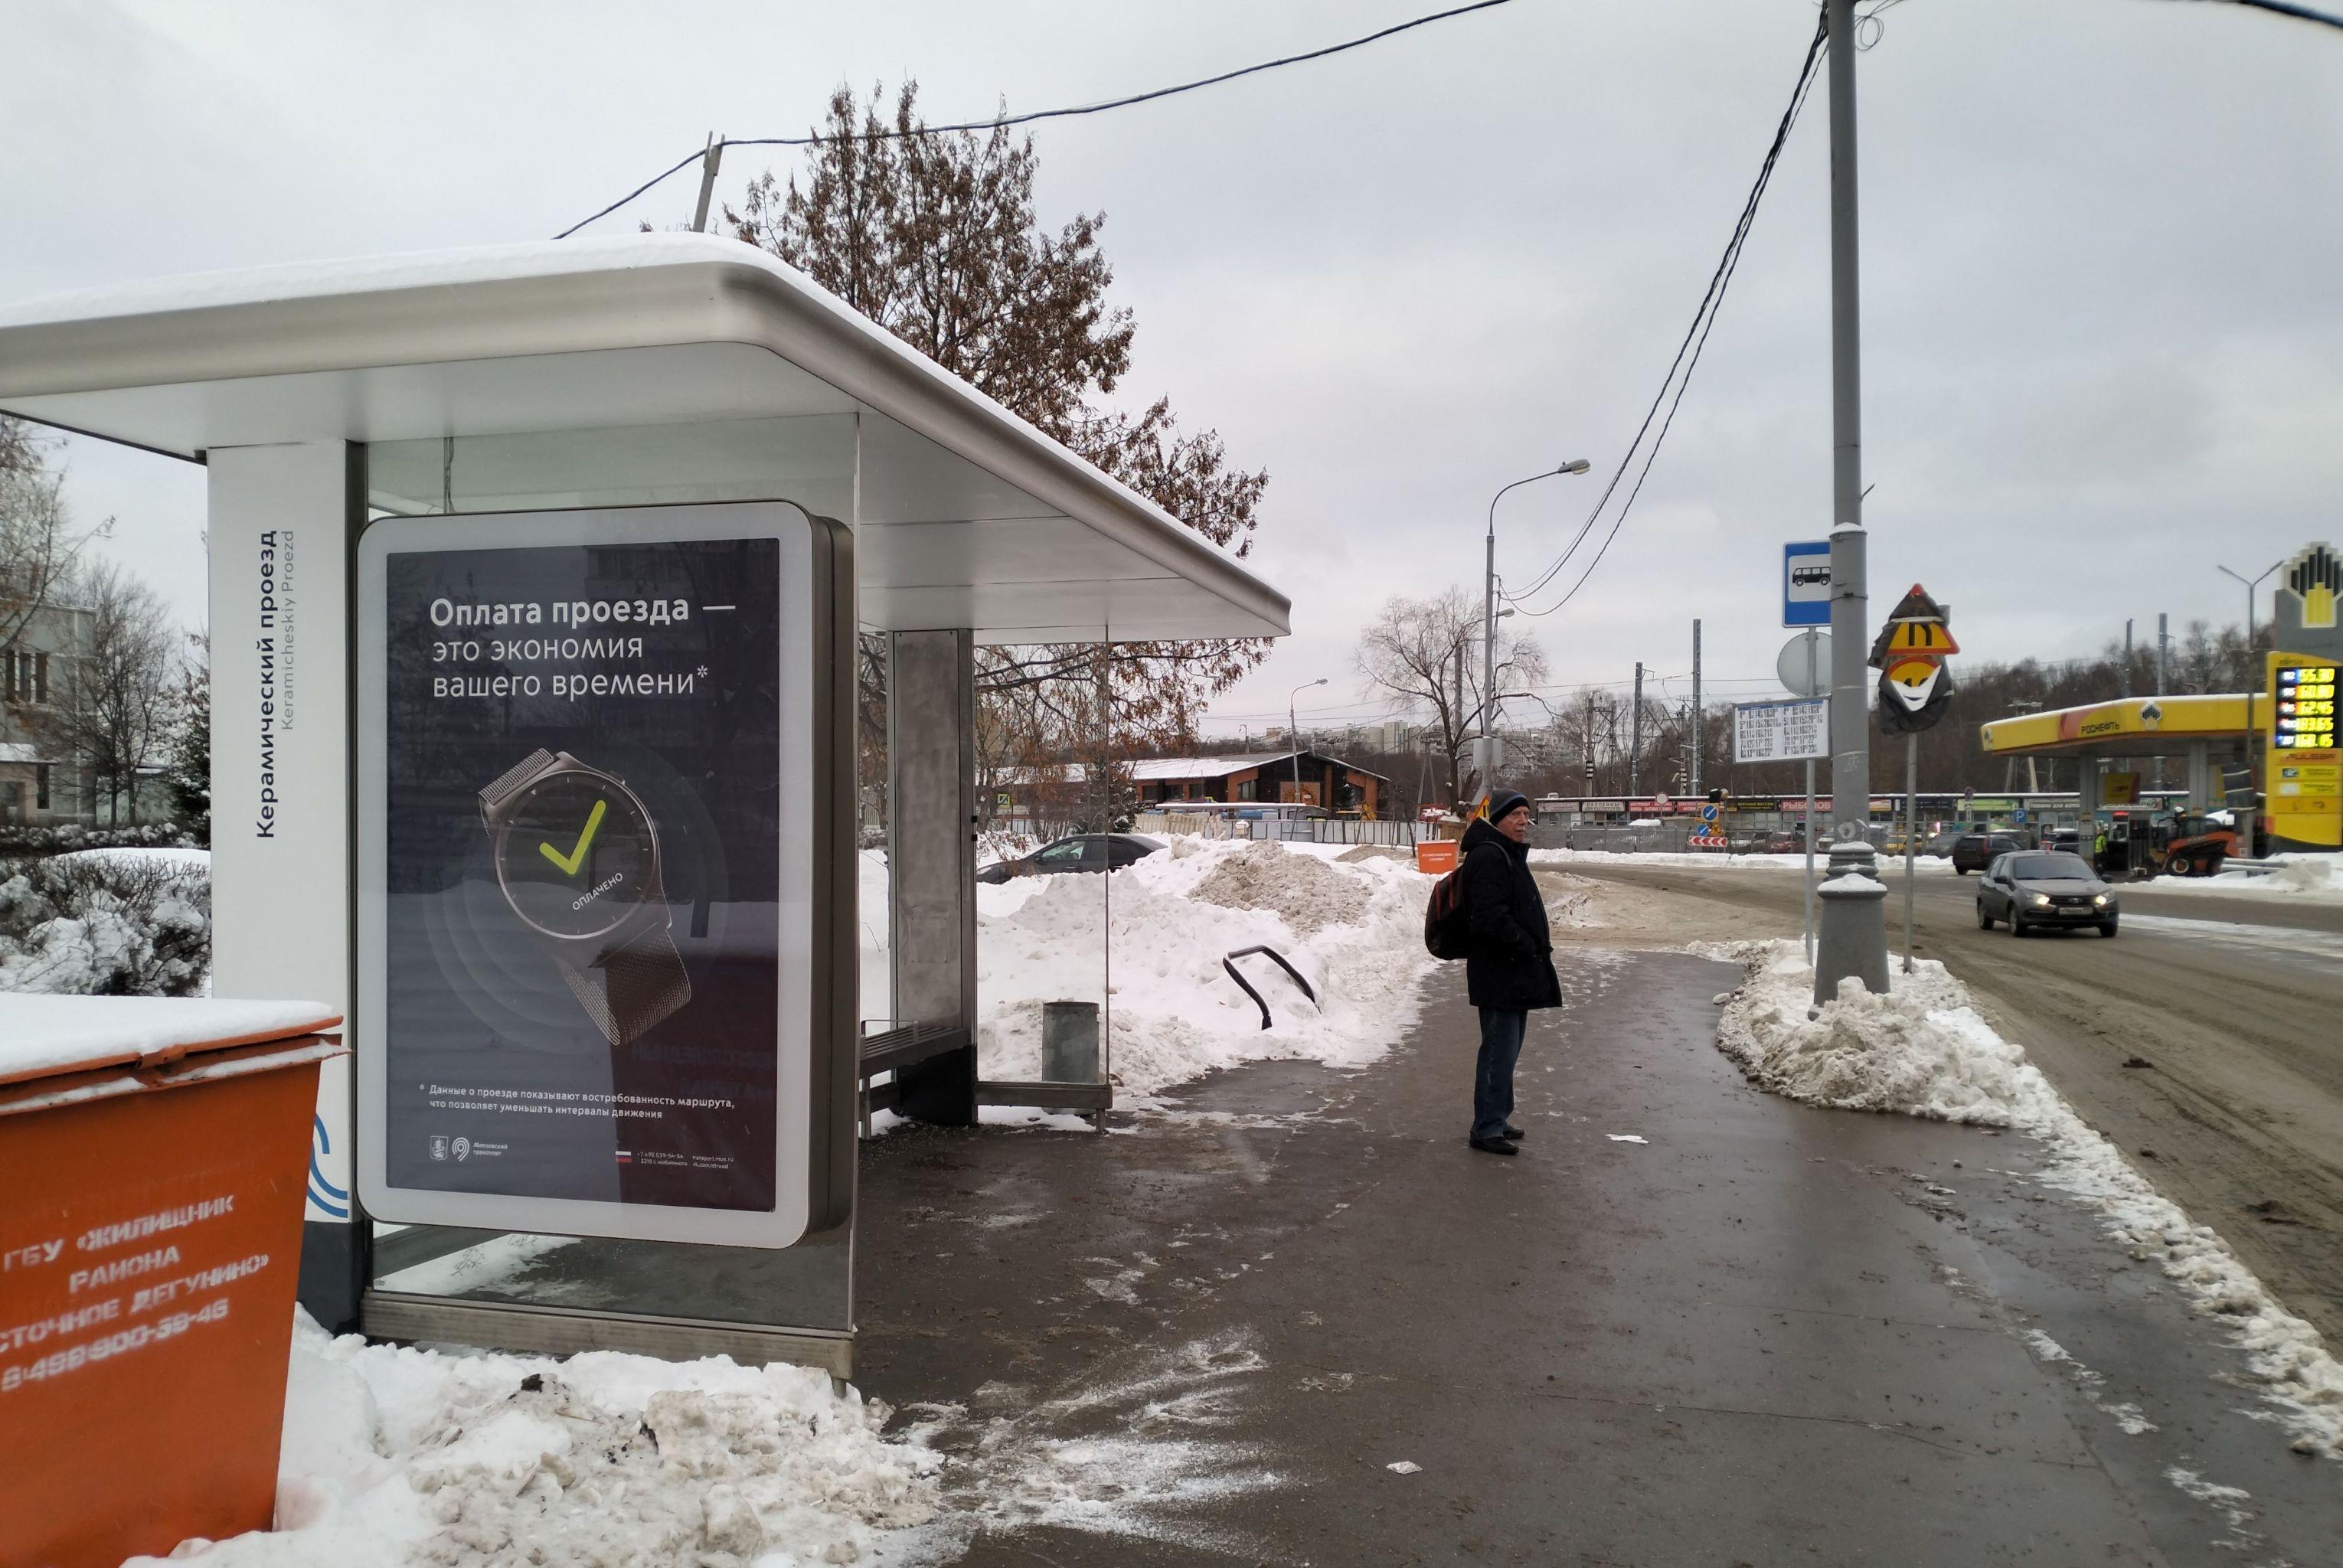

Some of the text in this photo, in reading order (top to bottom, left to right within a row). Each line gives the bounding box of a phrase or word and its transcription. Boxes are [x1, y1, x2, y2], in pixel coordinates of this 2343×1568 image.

[430, 597, 541, 626] Оплата
[552, 598, 689, 629] проезда
[282, 531, 296, 730] Keramicheskiy Proezd
[433, 637, 642, 662] это экономия
[257, 531, 278, 838] Керамический проезд
[433, 675, 540, 697] вашего
[572, 871, 624, 911] ОПЛАЧЕНО
[430, 1084, 466, 1096] Данные
[477, 1089, 518, 1099] проезде
[520, 1090, 580, 1102] показывают
[582, 1093, 675, 1106] востребованность
[677, 1098, 735, 1110] маршрута,
[430, 1100, 663, 1119] что позволяет уменьшать интервалы движения
[5, 1238, 64, 1272] ГБУ
